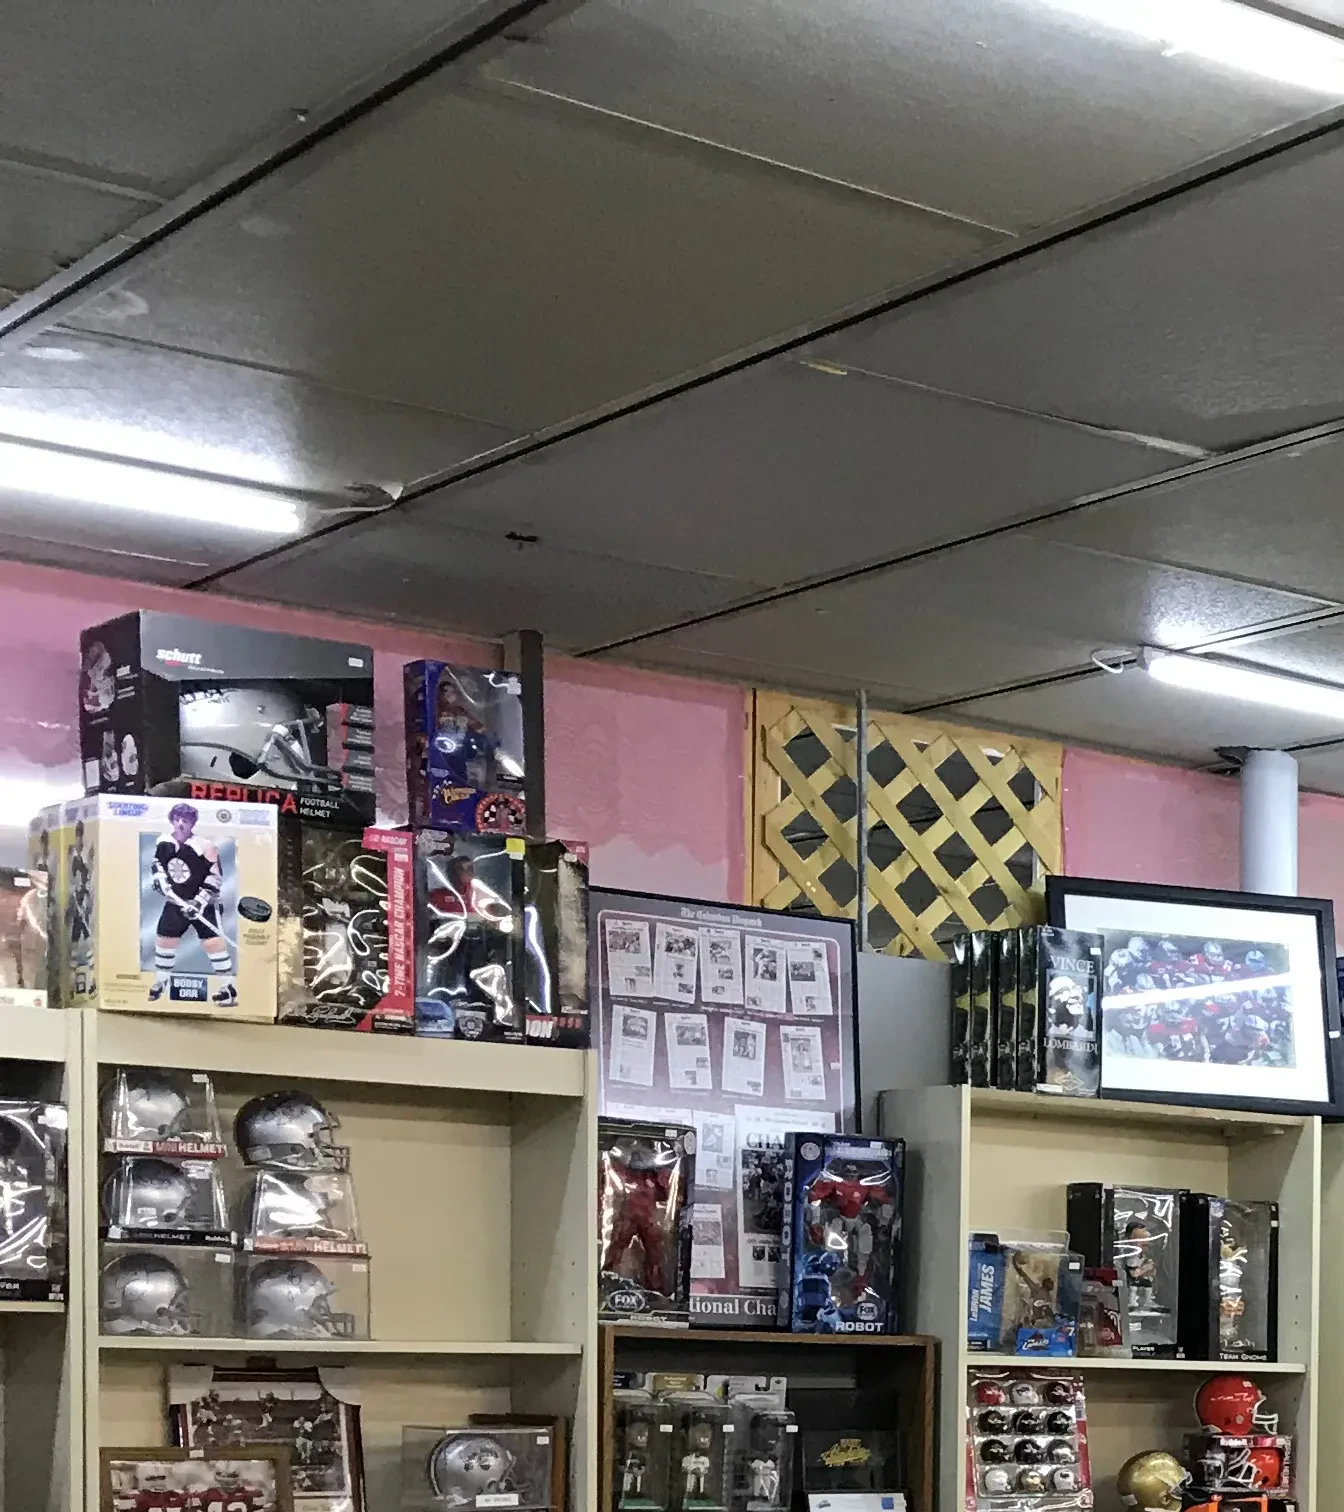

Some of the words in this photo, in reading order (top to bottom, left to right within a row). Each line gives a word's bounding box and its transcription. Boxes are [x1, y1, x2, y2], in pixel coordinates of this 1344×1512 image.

[156, 648, 202, 665] schutt
[300, 797, 340, 810] FOOTBALL
[300, 807, 331, 819] HELMET
[394, 867, 405, 919] CHAMPION
[394, 920, 405, 962] NASCAR
[1050, 955, 1095, 974] VINCE
[173, 978, 204, 989] BOBBY
[1043, 1037, 1098, 1054] LOMBARDI
[980, 1264, 996, 1313] JAMES
[614, 1294, 638, 1308] FOX
[859, 1306, 876, 1316] FOX
[836, 1321, 884, 1333] ROBOT
[1219, 1353, 1239, 1361] TEAM
